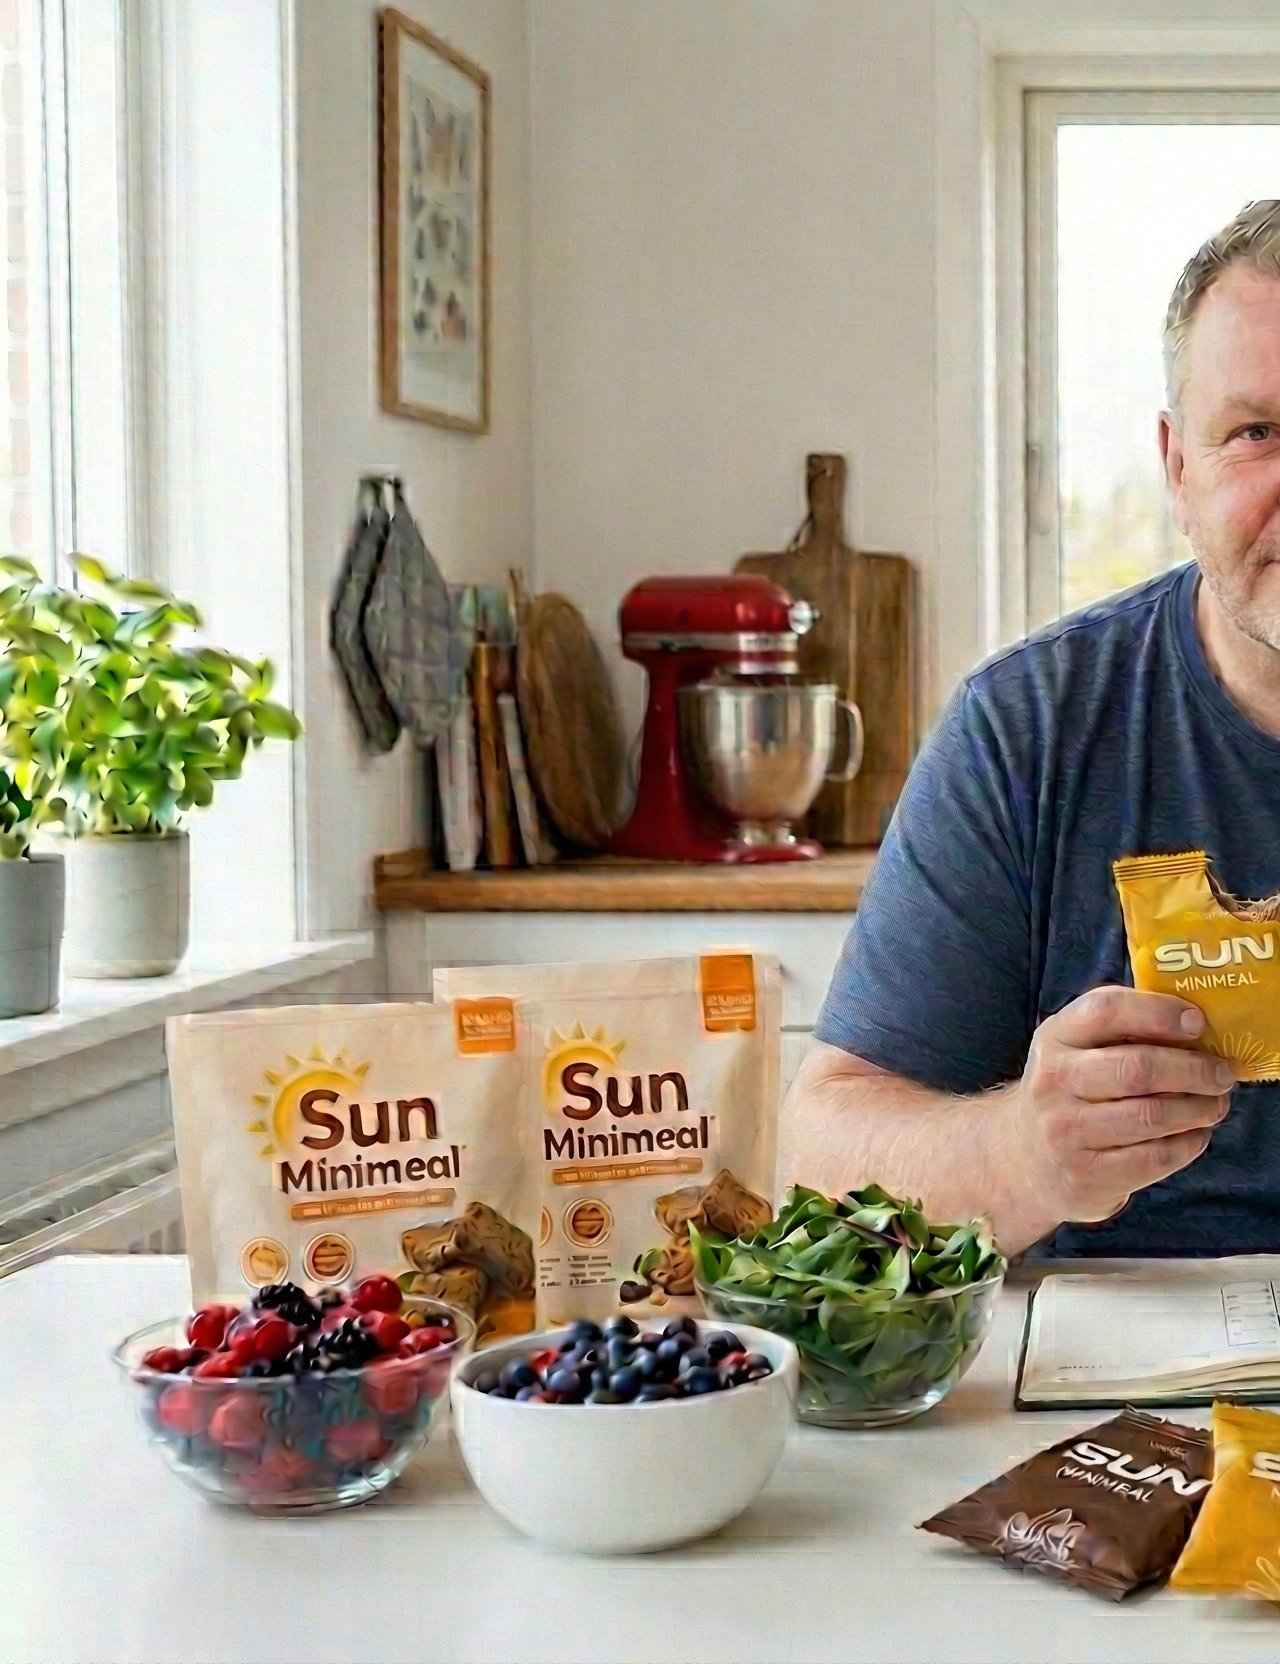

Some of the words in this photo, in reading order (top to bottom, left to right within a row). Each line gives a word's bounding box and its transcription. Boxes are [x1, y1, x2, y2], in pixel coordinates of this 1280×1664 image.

[1154, 932, 1275, 972] SUN
[1174, 971, 1260, 993] MINIMEAL
[561, 1062, 689, 1121] Sun
[299, 1088, 438, 1150] Sun
[543, 1115, 709, 1161] Minimeal
[280, 1144, 461, 1194] Minimeal
[1062, 1441, 1213, 1496] SUN
